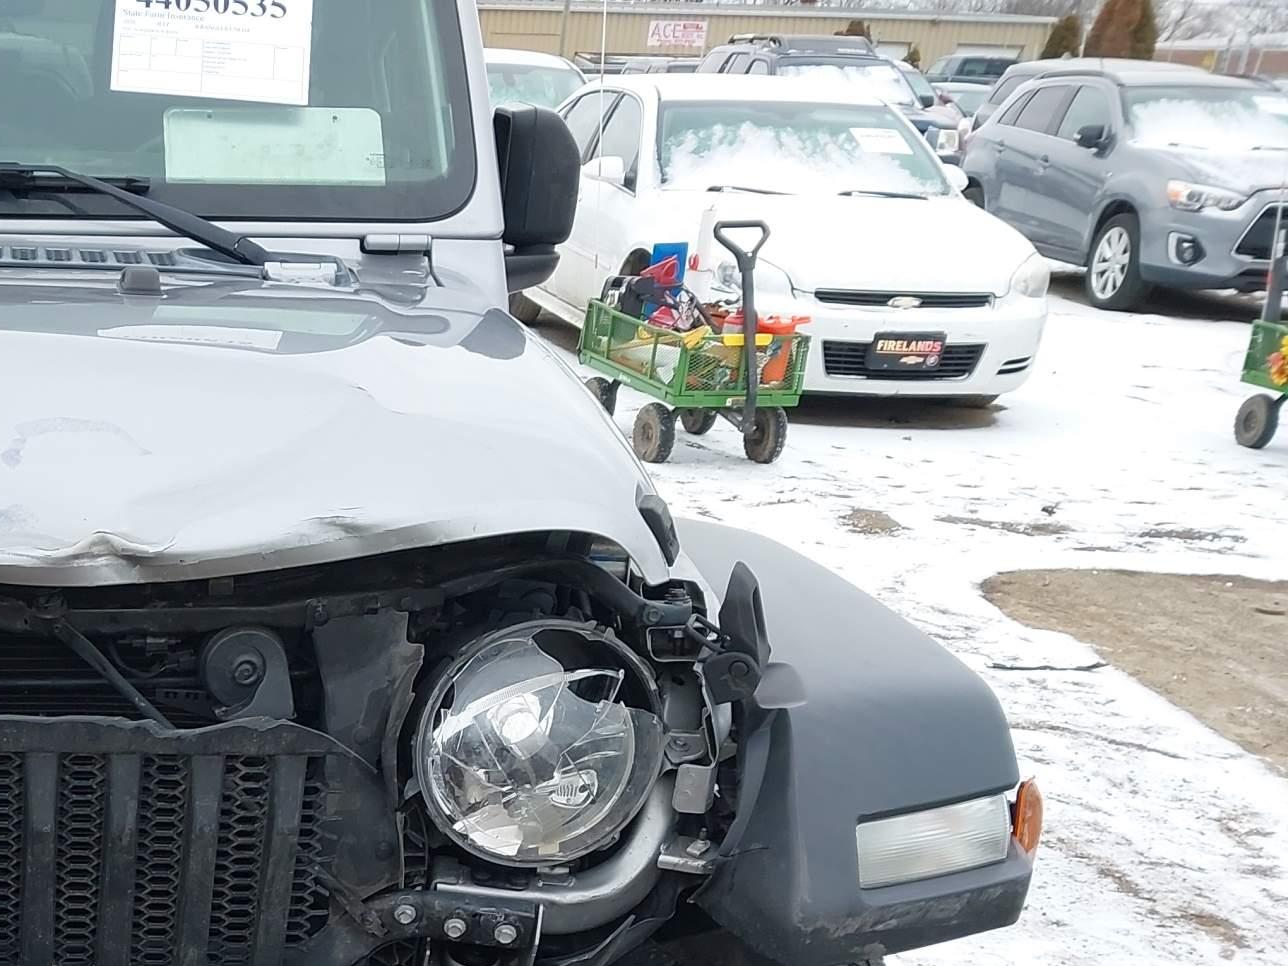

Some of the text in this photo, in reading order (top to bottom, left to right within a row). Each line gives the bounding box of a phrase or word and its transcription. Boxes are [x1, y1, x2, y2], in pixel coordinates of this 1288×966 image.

[135, 0, 288, 18] 0535
[651, 23, 682, 38] ACE
[876, 340, 942, 352] FIRELANDS
